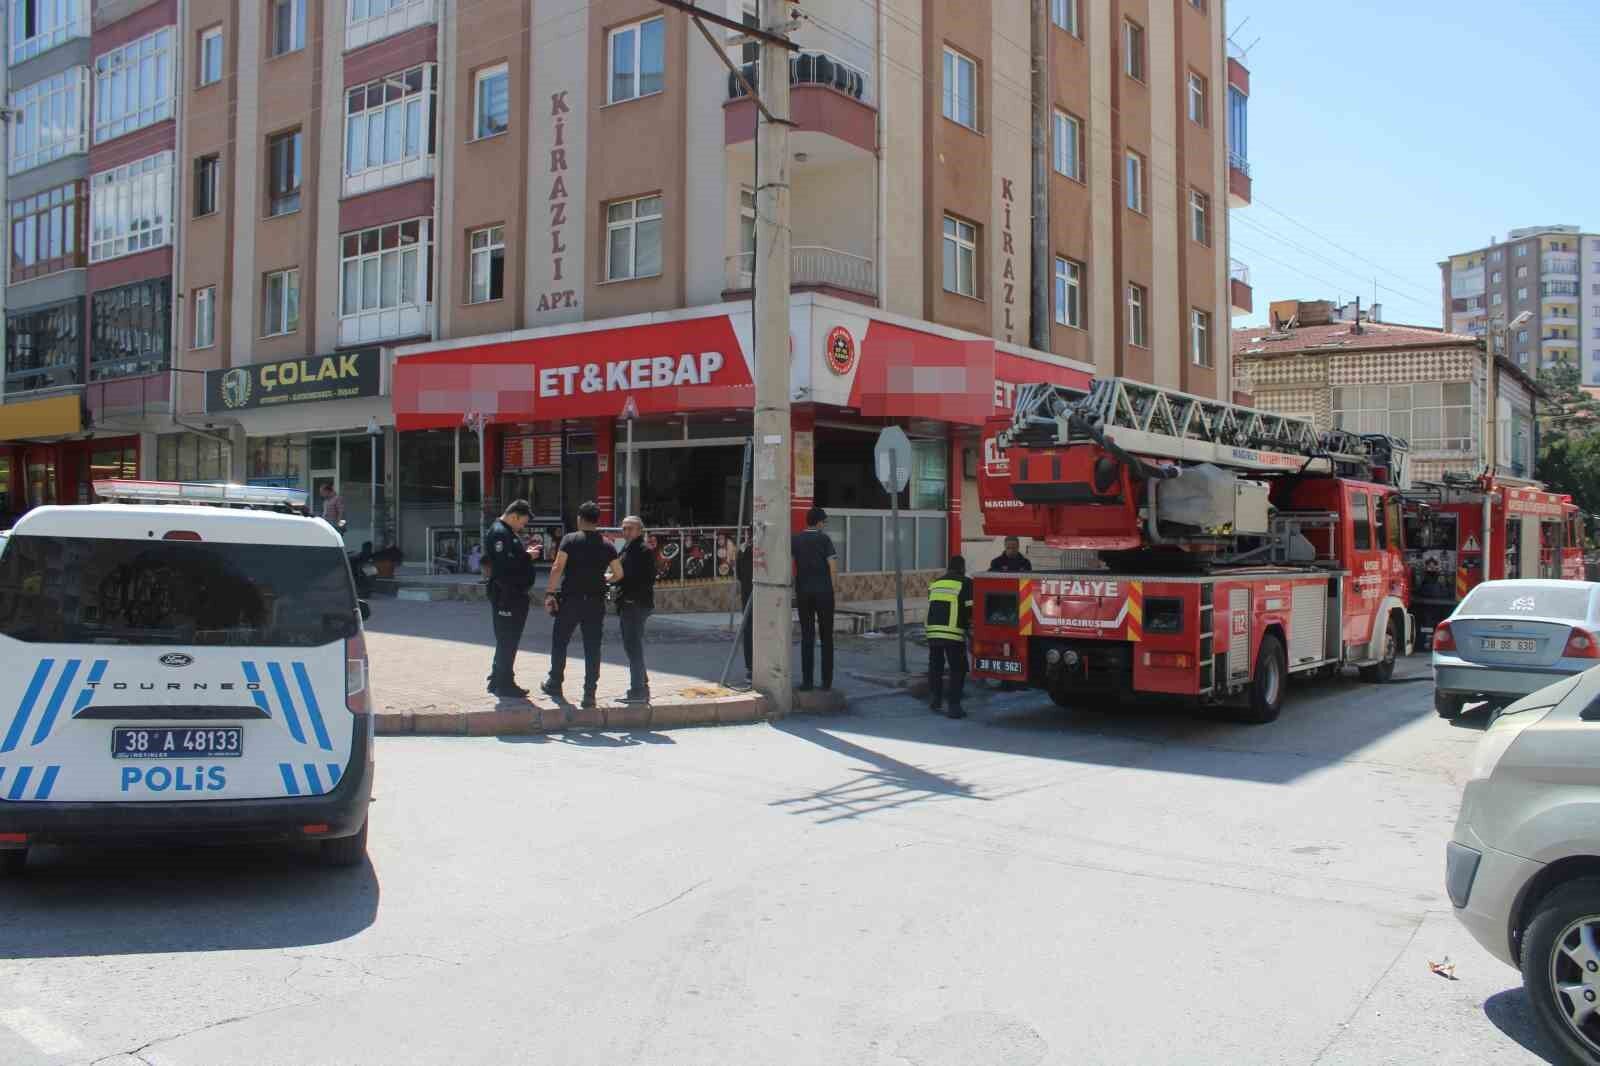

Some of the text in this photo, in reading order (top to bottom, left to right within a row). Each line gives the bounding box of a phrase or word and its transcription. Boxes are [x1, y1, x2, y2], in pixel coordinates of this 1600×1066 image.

[535, 290, 578, 312] APT.
[259, 353, 360, 392] ÇOLAK
[539, 351, 724, 398] ET&KEBAP
[87, 682, 260, 691] TOURNEO
[126, 731, 238, 751] 38 A 48133
